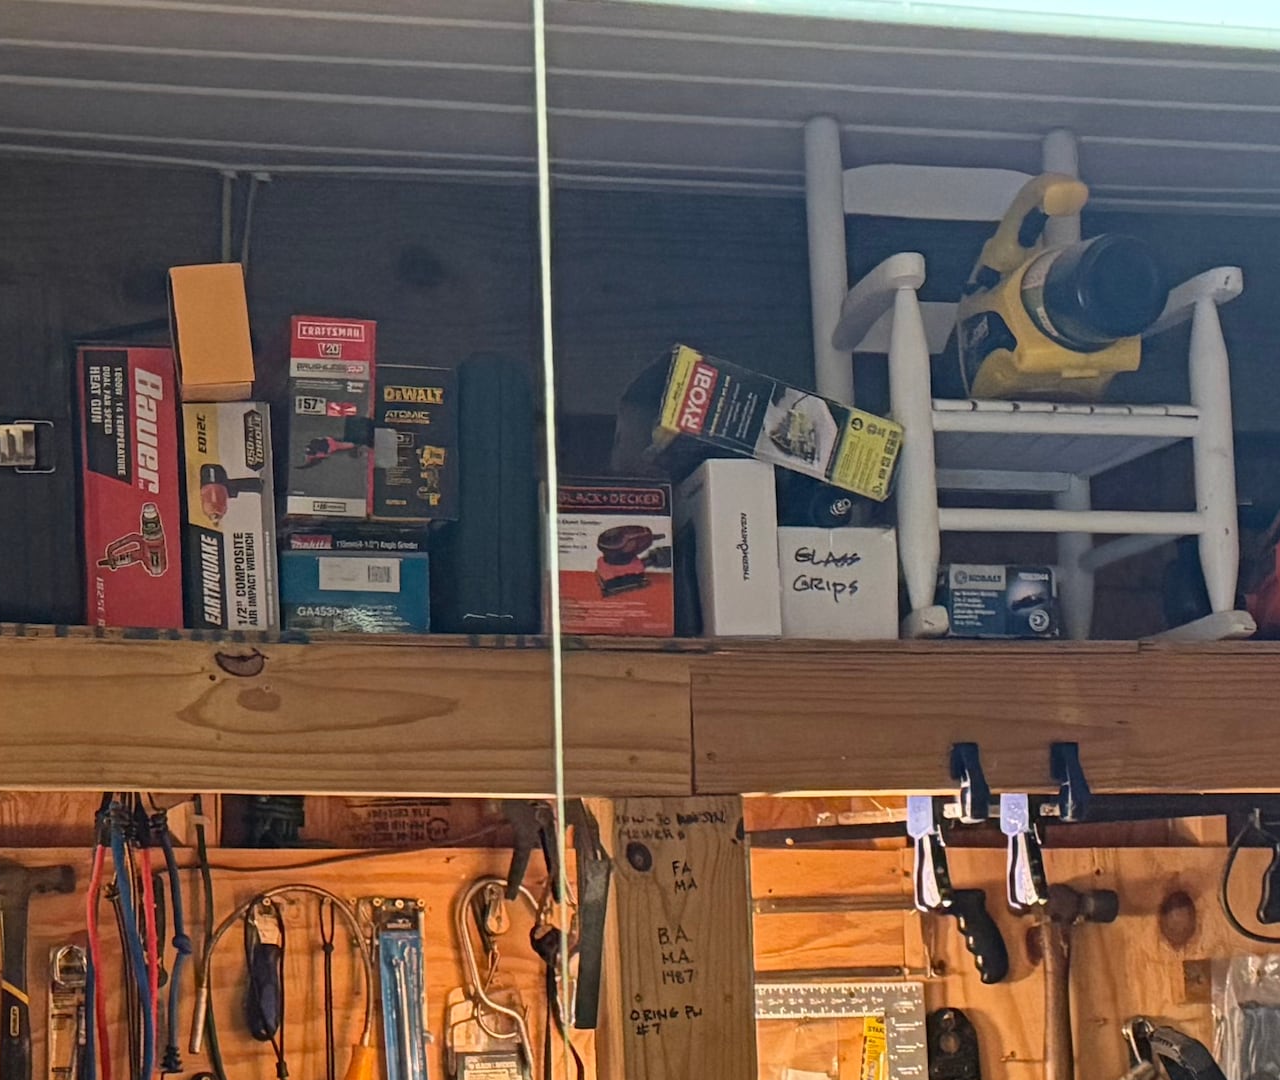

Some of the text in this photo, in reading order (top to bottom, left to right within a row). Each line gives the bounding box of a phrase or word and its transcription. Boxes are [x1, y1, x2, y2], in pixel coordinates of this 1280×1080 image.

[89, 366, 102, 424] HEAT GUN
[681, 367, 714, 429] RYOBI
[134, 367, 164, 495] Bauer
[200, 534, 222, 626] EARTHQUAKE
[233, 532, 246, 598] COMPOSITE
[246, 532, 258, 626] AIR IMPACT WRENCH
[794, 547, 861, 567] GLASS
